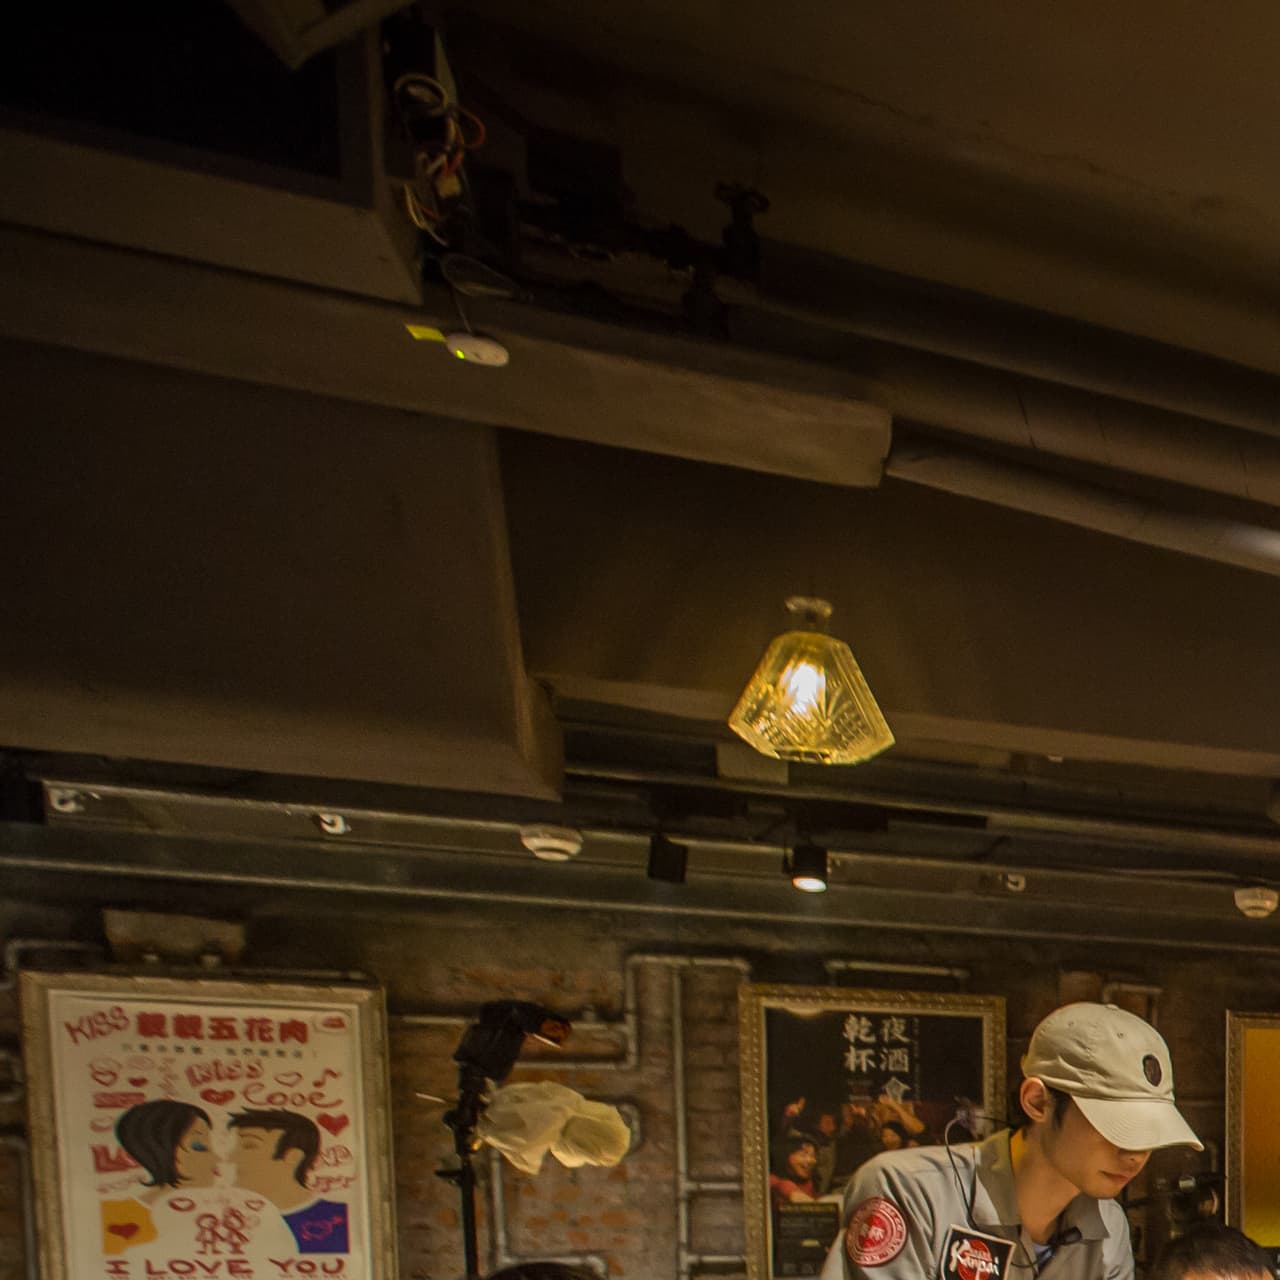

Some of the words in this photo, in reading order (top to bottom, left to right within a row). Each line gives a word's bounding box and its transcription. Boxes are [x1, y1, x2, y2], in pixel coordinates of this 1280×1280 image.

[106, 1260, 130, 1275] I
[145, 1260, 254, 1276] LOVE
[269, 1258, 345, 1274] YOU
